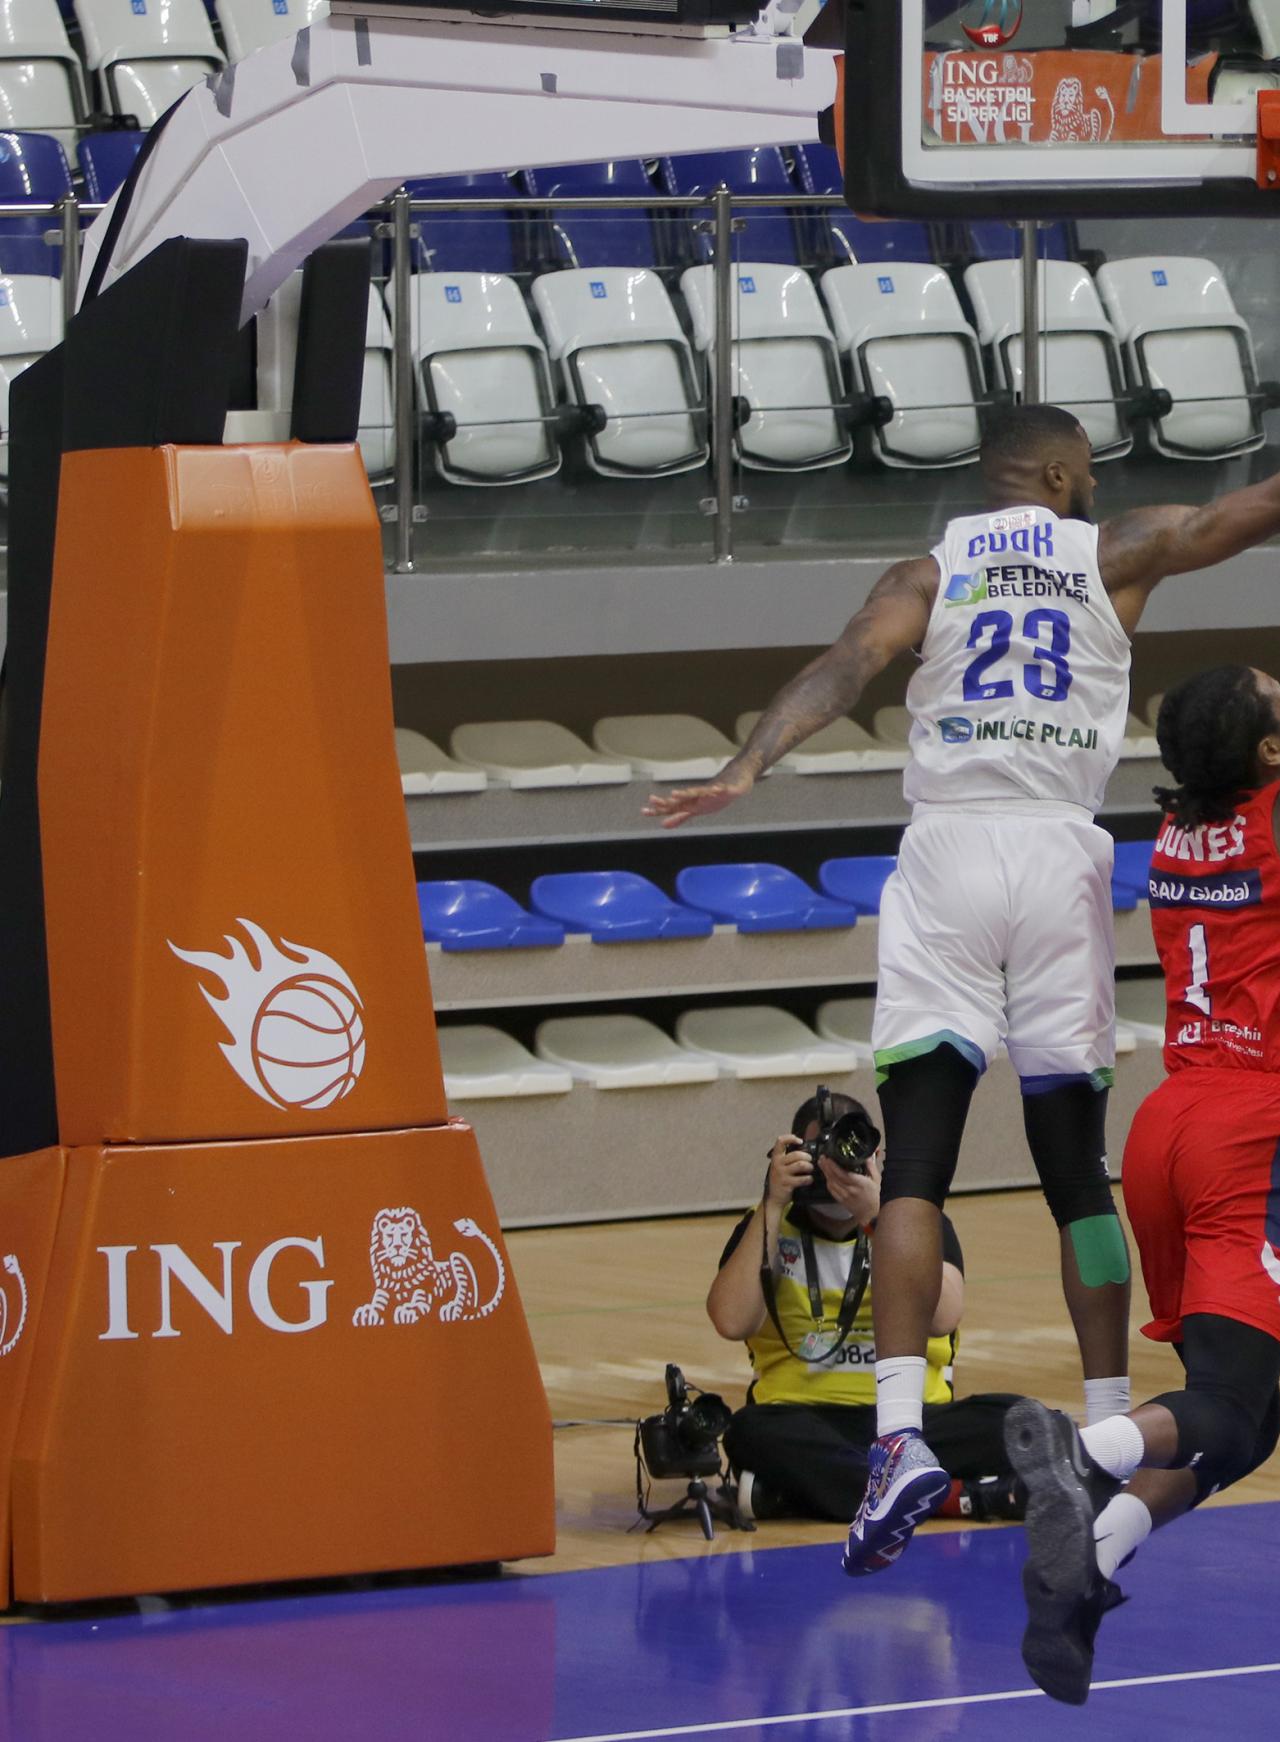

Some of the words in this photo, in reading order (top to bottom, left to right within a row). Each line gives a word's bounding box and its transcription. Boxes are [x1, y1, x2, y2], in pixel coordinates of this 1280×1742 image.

[945, 60, 1000, 85] ING
[944, 87, 1036, 103] BASKETBOL
[962, 608, 1074, 702] 23
[1040, 722, 1099, 751] PLAJI
[1149, 879, 1185, 901] BAU
[1189, 882, 1250, 902] Global
[1184, 922, 1212, 1017] 1
[97, 1234, 335, 1341] ING
